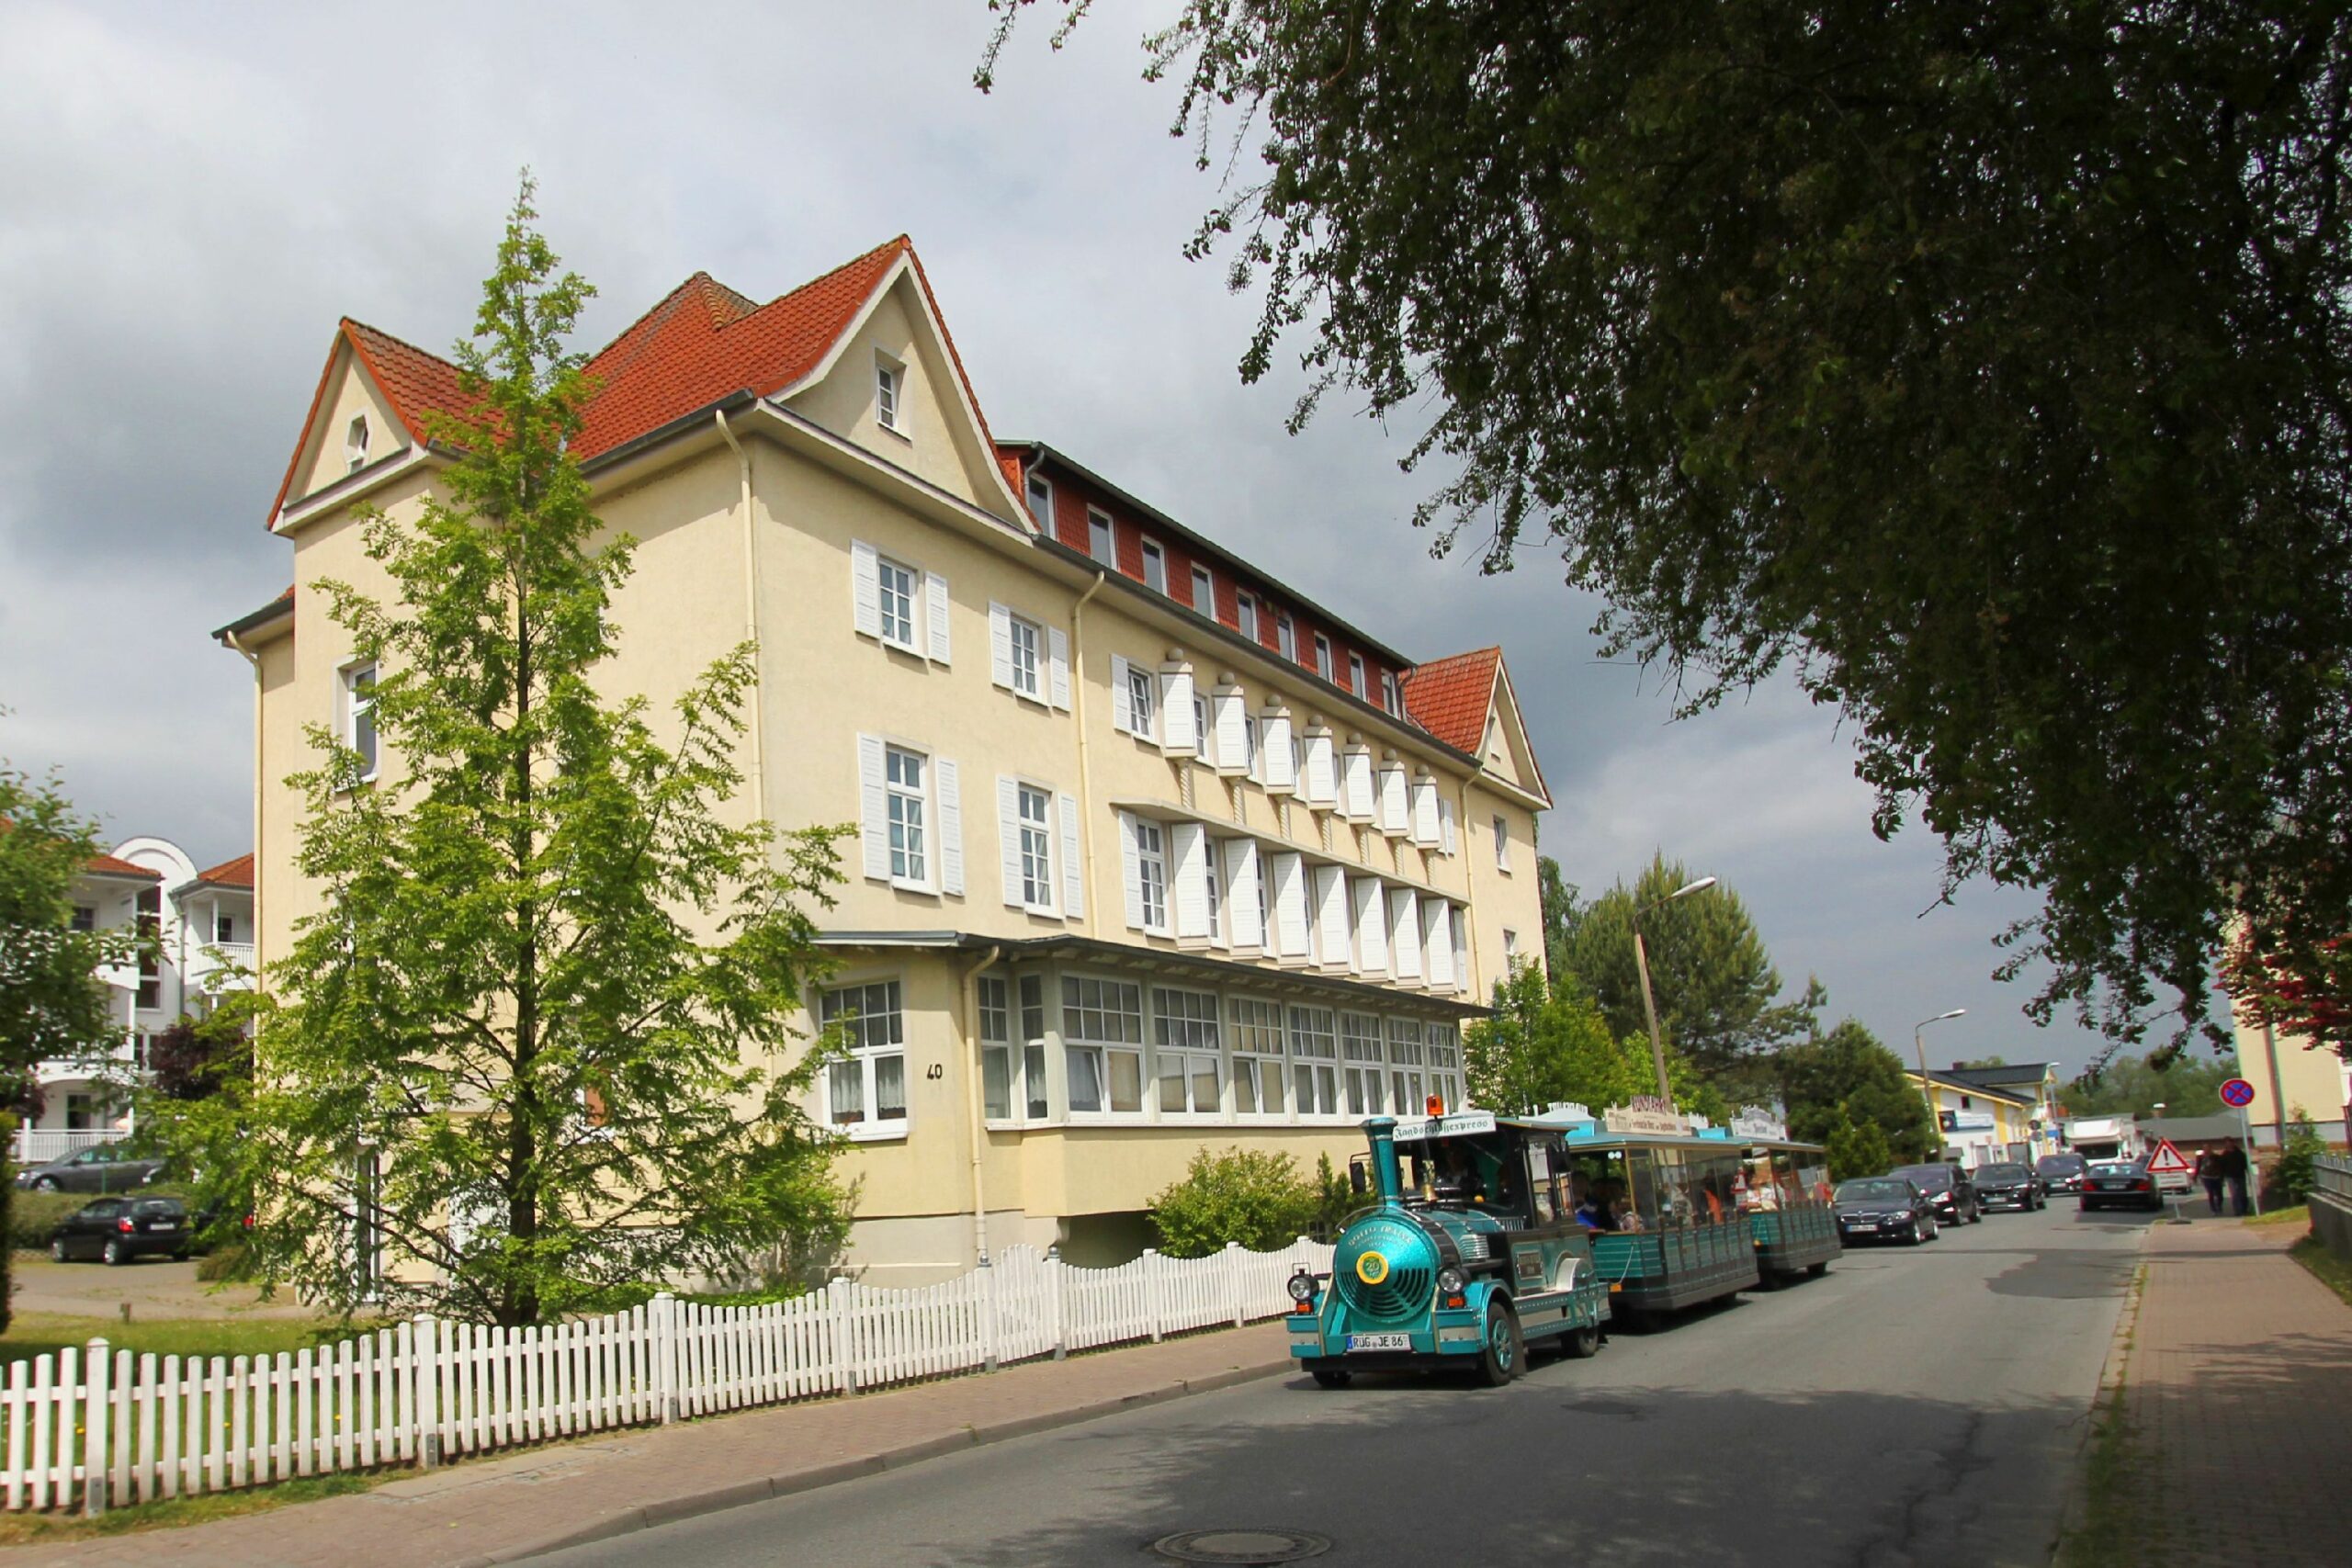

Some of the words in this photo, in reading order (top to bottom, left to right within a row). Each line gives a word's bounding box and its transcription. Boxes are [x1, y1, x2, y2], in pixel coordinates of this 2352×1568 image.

[927, 1064, 943, 1080] 40
[1352, 1337, 1371, 1348] RÜG
[1378, 1337, 1389, 1347] JE
[1391, 1336, 1404, 1347] 86
